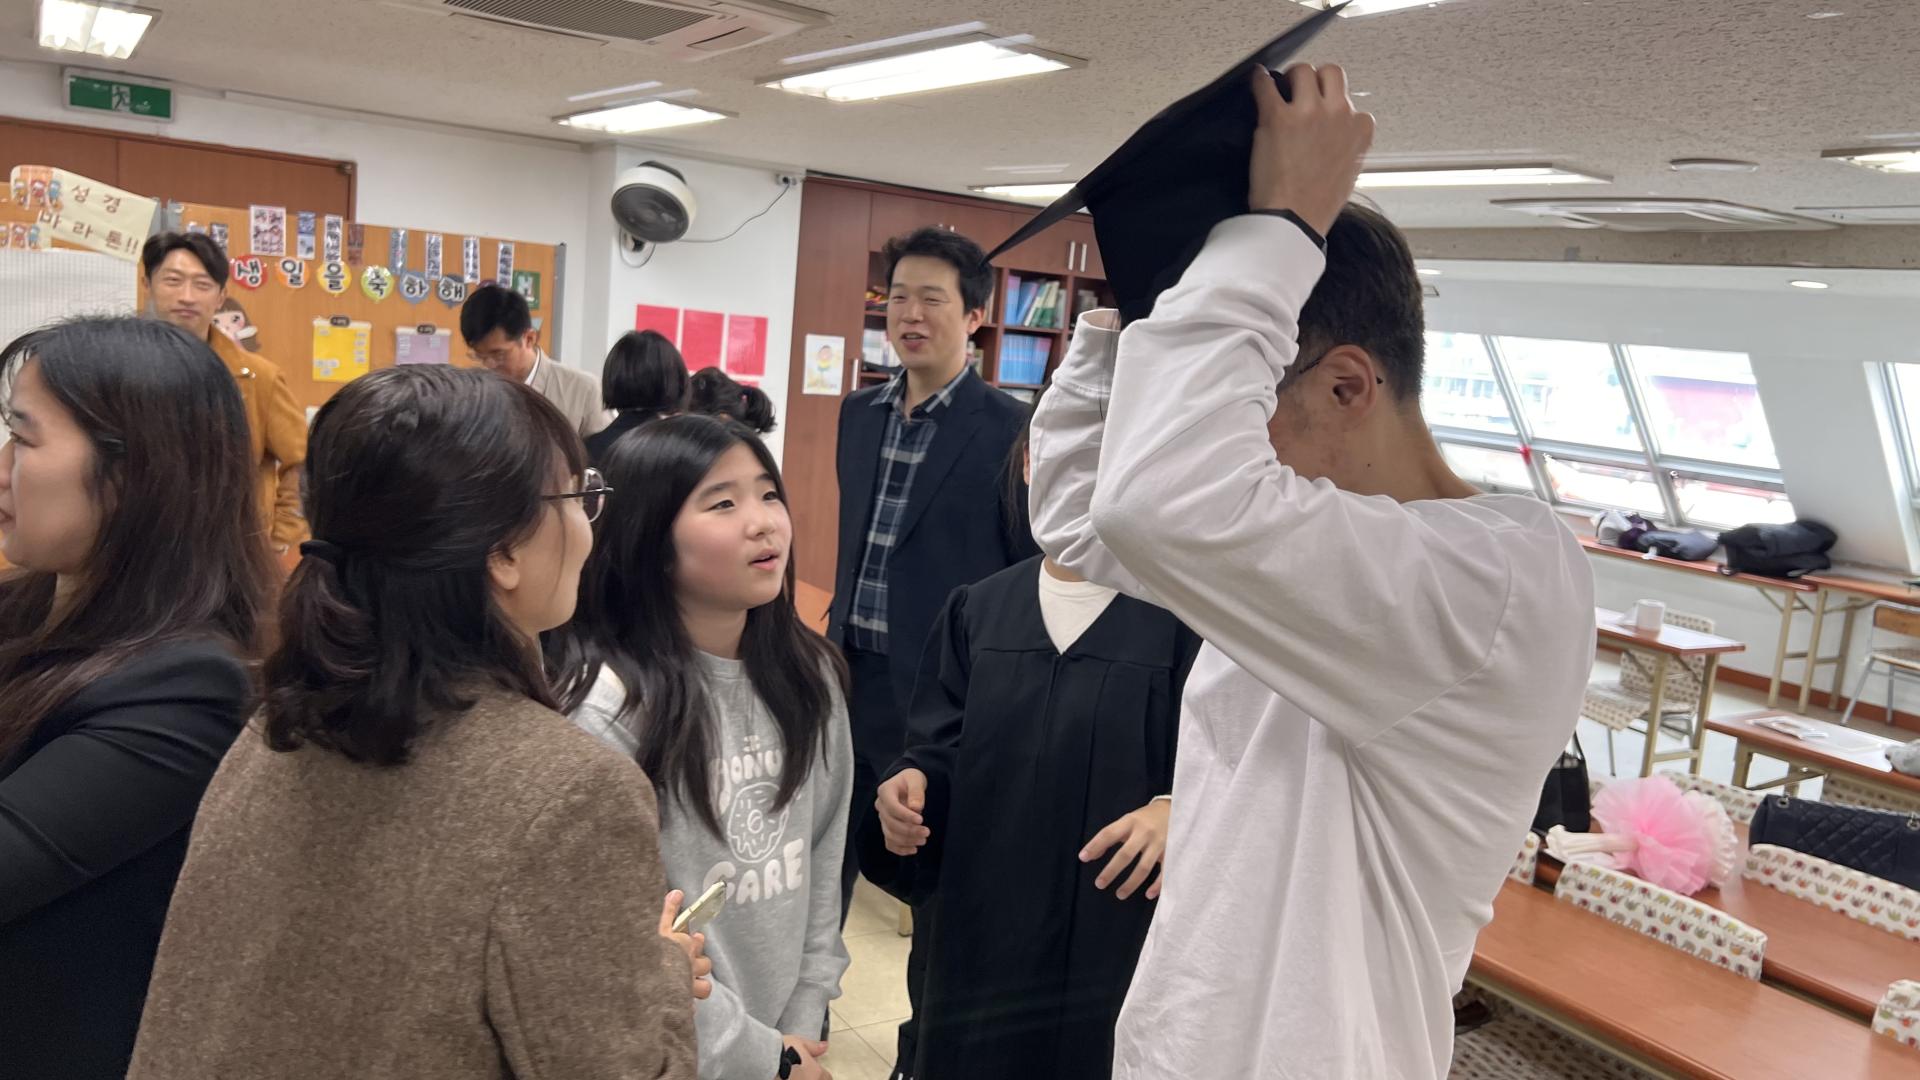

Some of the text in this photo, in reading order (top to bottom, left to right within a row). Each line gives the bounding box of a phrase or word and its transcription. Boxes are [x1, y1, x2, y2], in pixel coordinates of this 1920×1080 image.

[71, 184, 121, 213] 성경
[236, 259, 464, 300] 생일을 축하해
